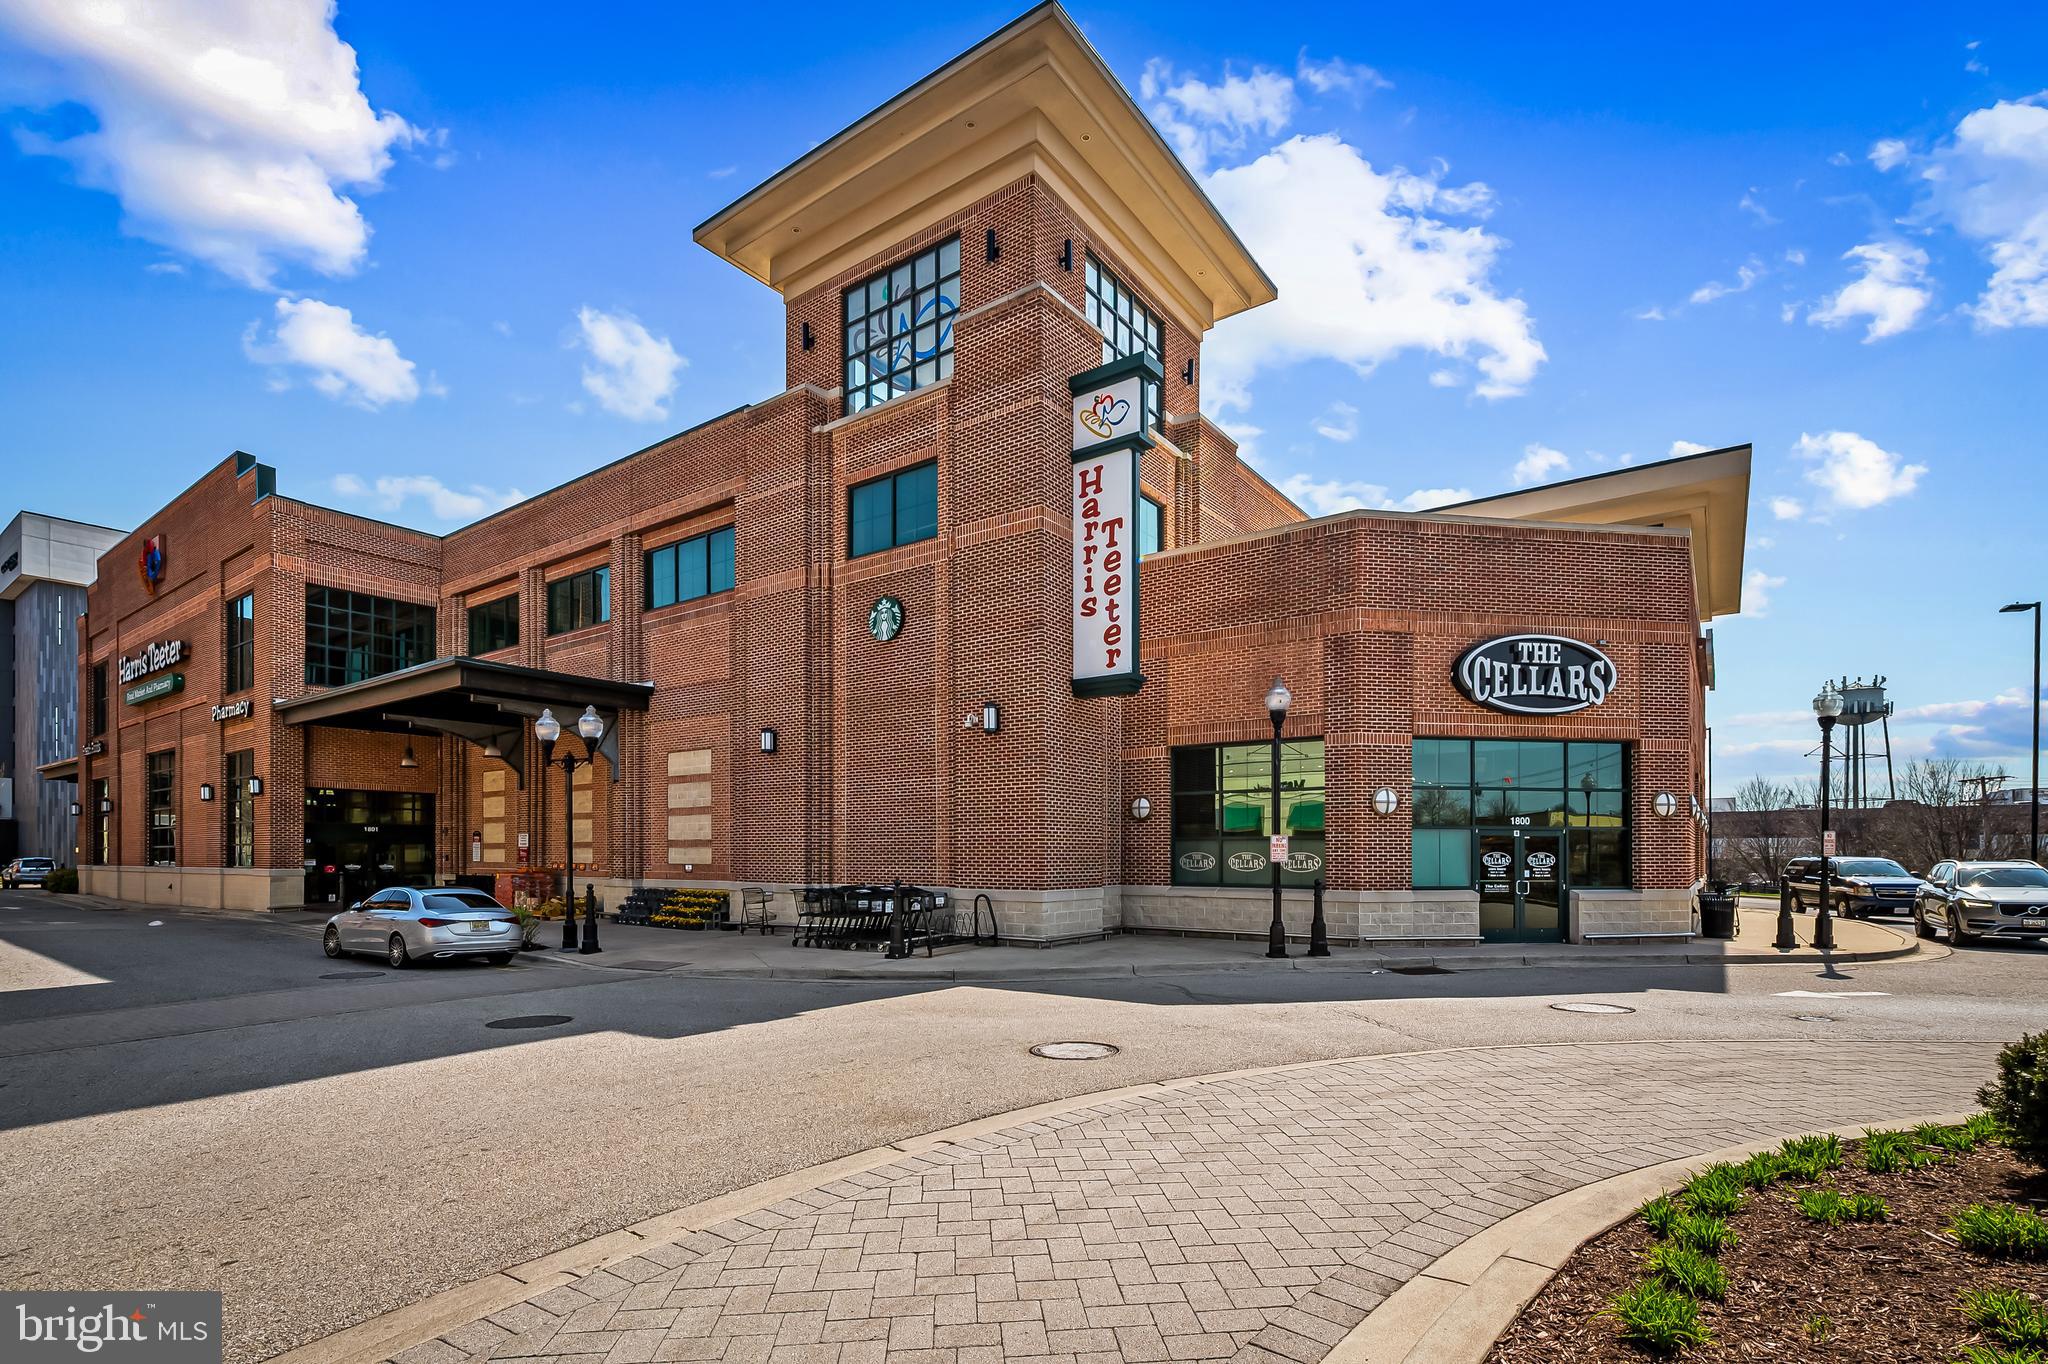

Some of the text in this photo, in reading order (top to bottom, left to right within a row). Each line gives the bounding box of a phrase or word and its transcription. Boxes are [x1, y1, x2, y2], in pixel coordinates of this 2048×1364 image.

[1078, 464, 1104, 617] Harris
[1101, 517, 1123, 669] Teeter
[118, 640, 181, 684] Harris Teeter
[1518, 642, 1561, 664] THE
[1473, 655, 1605, 706] CELLARS
[211, 699, 249, 721] Pharmacy
[1510, 816, 1530, 825] 1800
[1182, 858, 1214, 868] CELLARS
[1231, 857, 1265, 870] CELLARS
